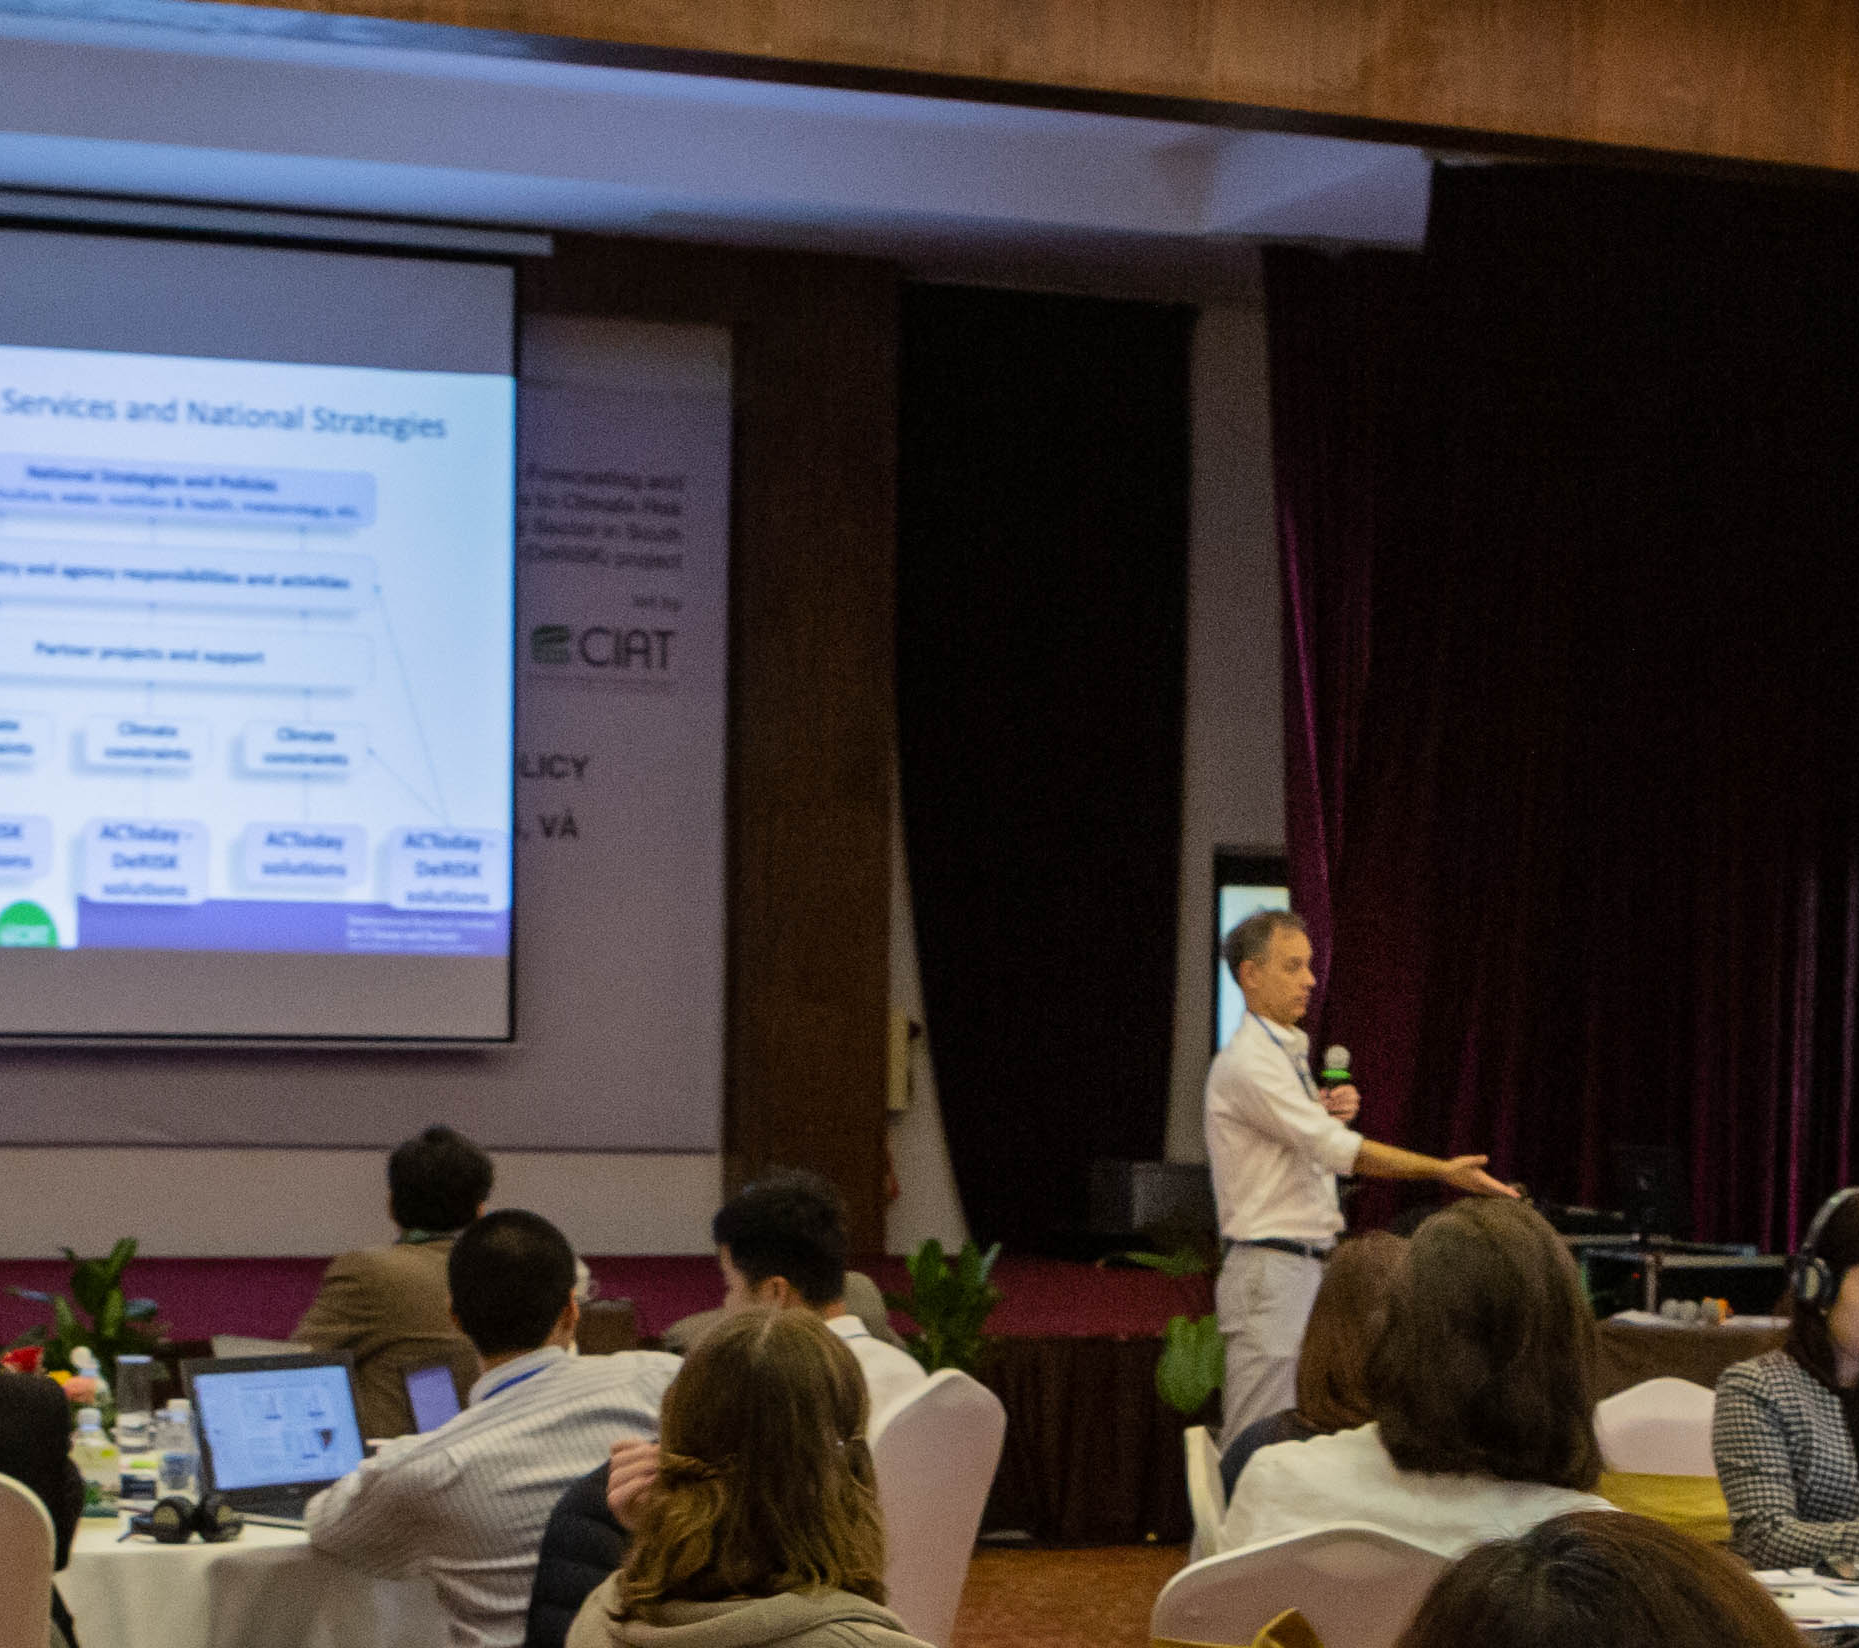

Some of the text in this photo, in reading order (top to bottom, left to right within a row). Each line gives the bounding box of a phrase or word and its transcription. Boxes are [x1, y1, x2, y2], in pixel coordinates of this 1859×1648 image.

[2, 387, 116, 418] Services
[126, 397, 178, 423] and
[188, 401, 304, 430] National
[313, 405, 447, 442] Strategies
[27, 465, 279, 493] National Strategies and Policies
[25, 561, 56, 576] and
[61, 567, 116, 582] agency
[122, 567, 241, 586] responsibilities
[246, 572, 277, 587] and
[280, 573, 350, 590] activities
[34, 640, 265, 666] Partner projects and support
[579, 625, 676, 670] CIAT
[118, 719, 179, 737] Climate
[275, 725, 336, 744] Climate
[104, 746, 191, 760] constraints
[262, 751, 349, 767] constraints
[100, 823, 180, 845] ACToday
[265, 831, 345, 853] ACToday
[404, 832, 483, 854] ACToday
[111, 852, 178, 871] DeRISK
[261, 859, 347, 877] solutions
[414, 860, 482, 878] DeRISK
[102, 880, 188, 896] solutions
[406, 889, 490, 905] solutions
